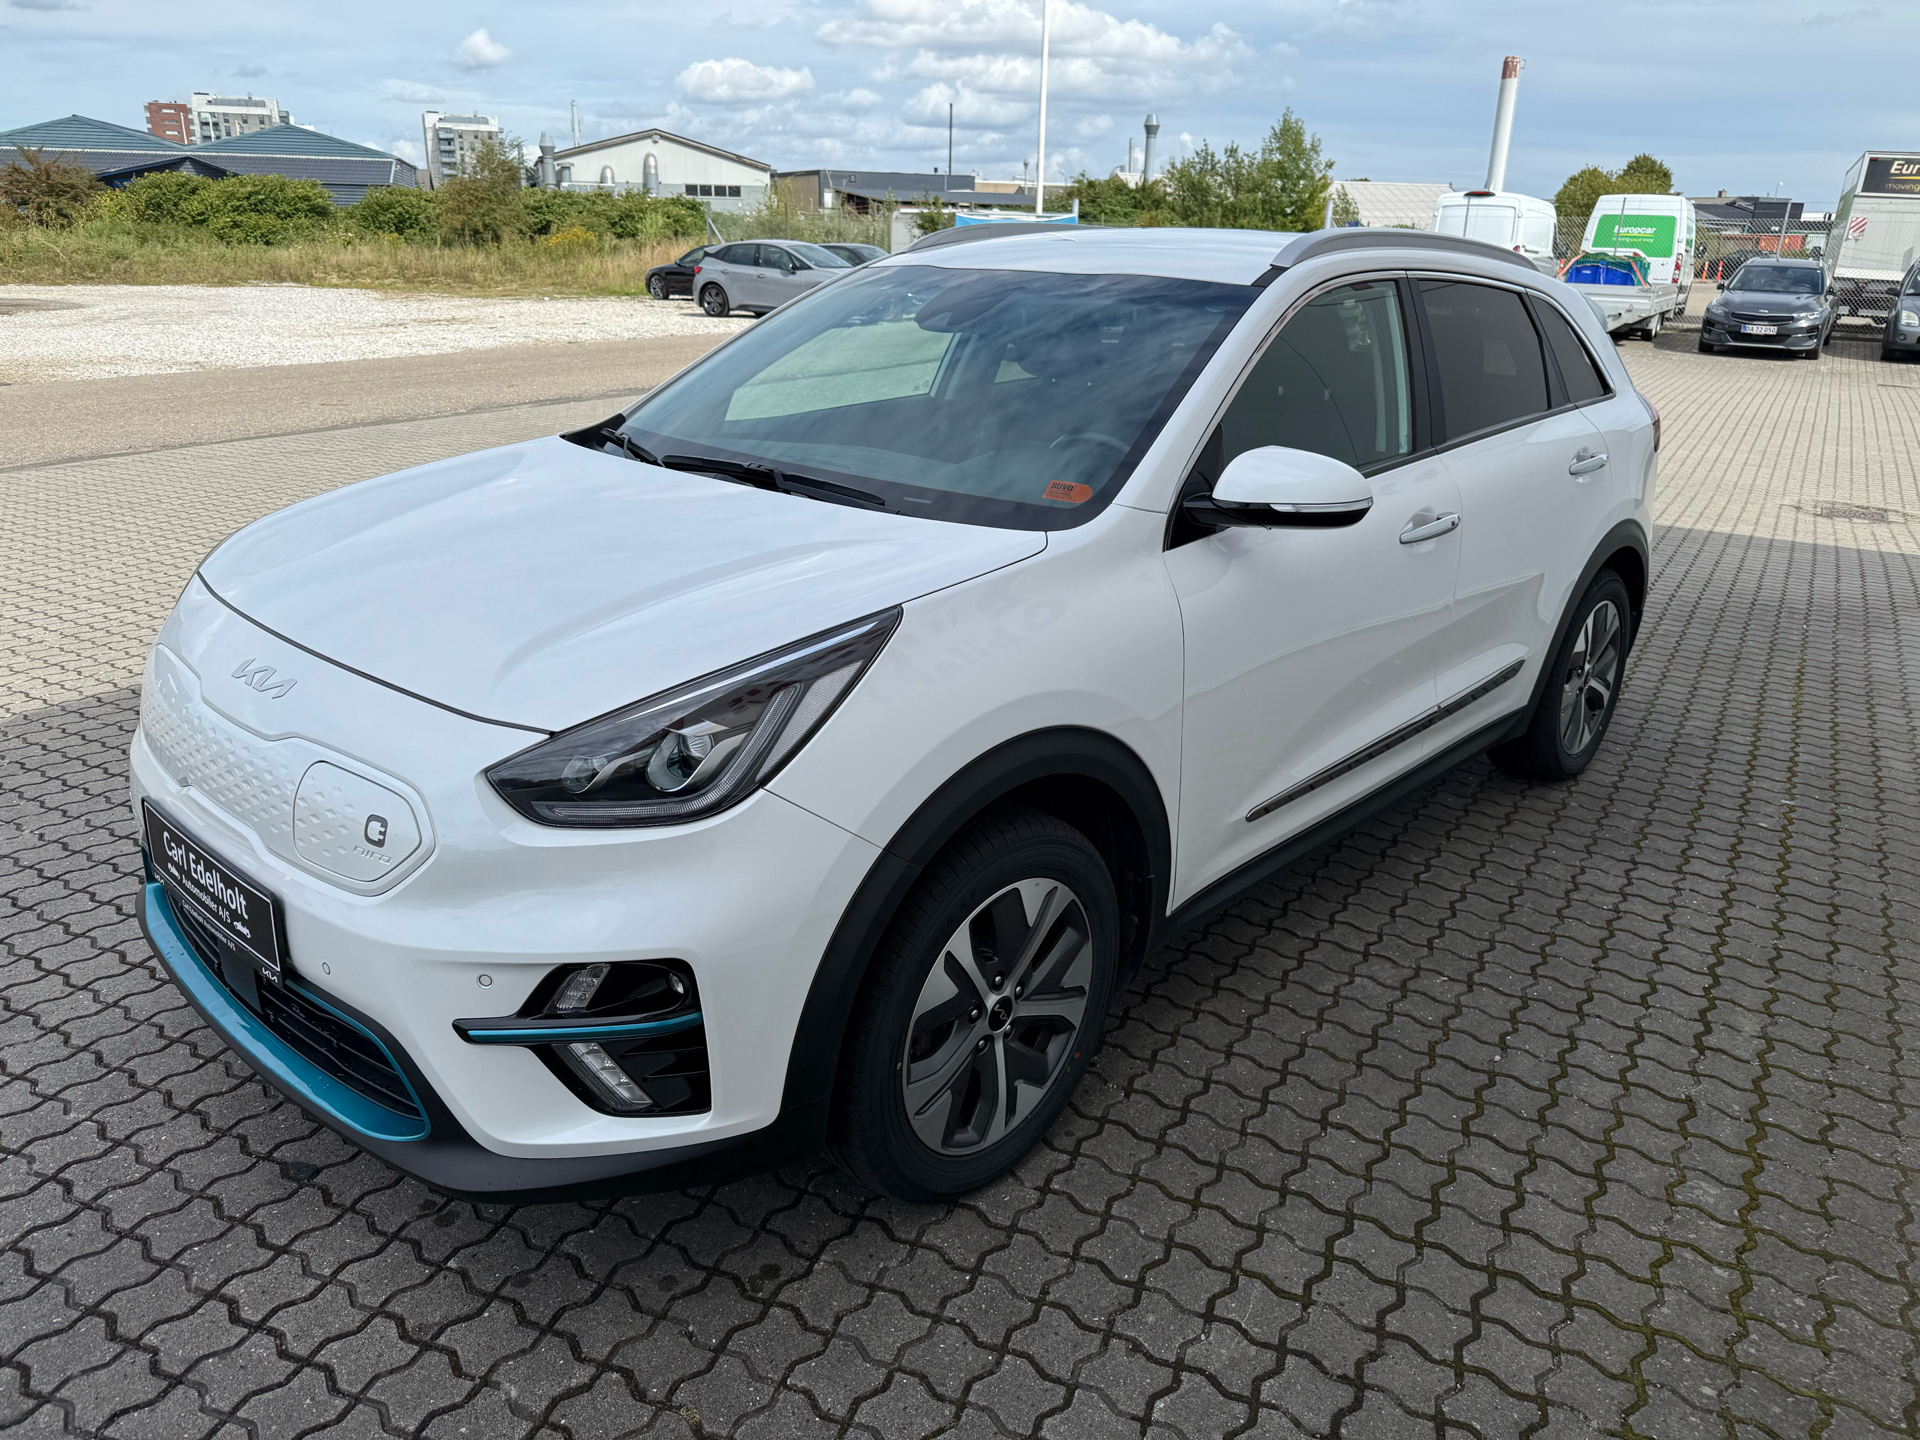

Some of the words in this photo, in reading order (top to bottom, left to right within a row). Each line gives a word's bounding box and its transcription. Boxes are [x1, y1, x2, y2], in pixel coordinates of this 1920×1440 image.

[1613, 225, 1656, 235] Europcar
[1051, 482, 1075, 492] SUVO
[231, 658, 298, 700] KIA
[163, 831, 187, 871] Carl
[188, 852, 248, 920] Edelholt
[182, 874, 218, 913] Automobiler
[218, 905, 231, 923] A/S
[262, 967, 278, 983] KIA
